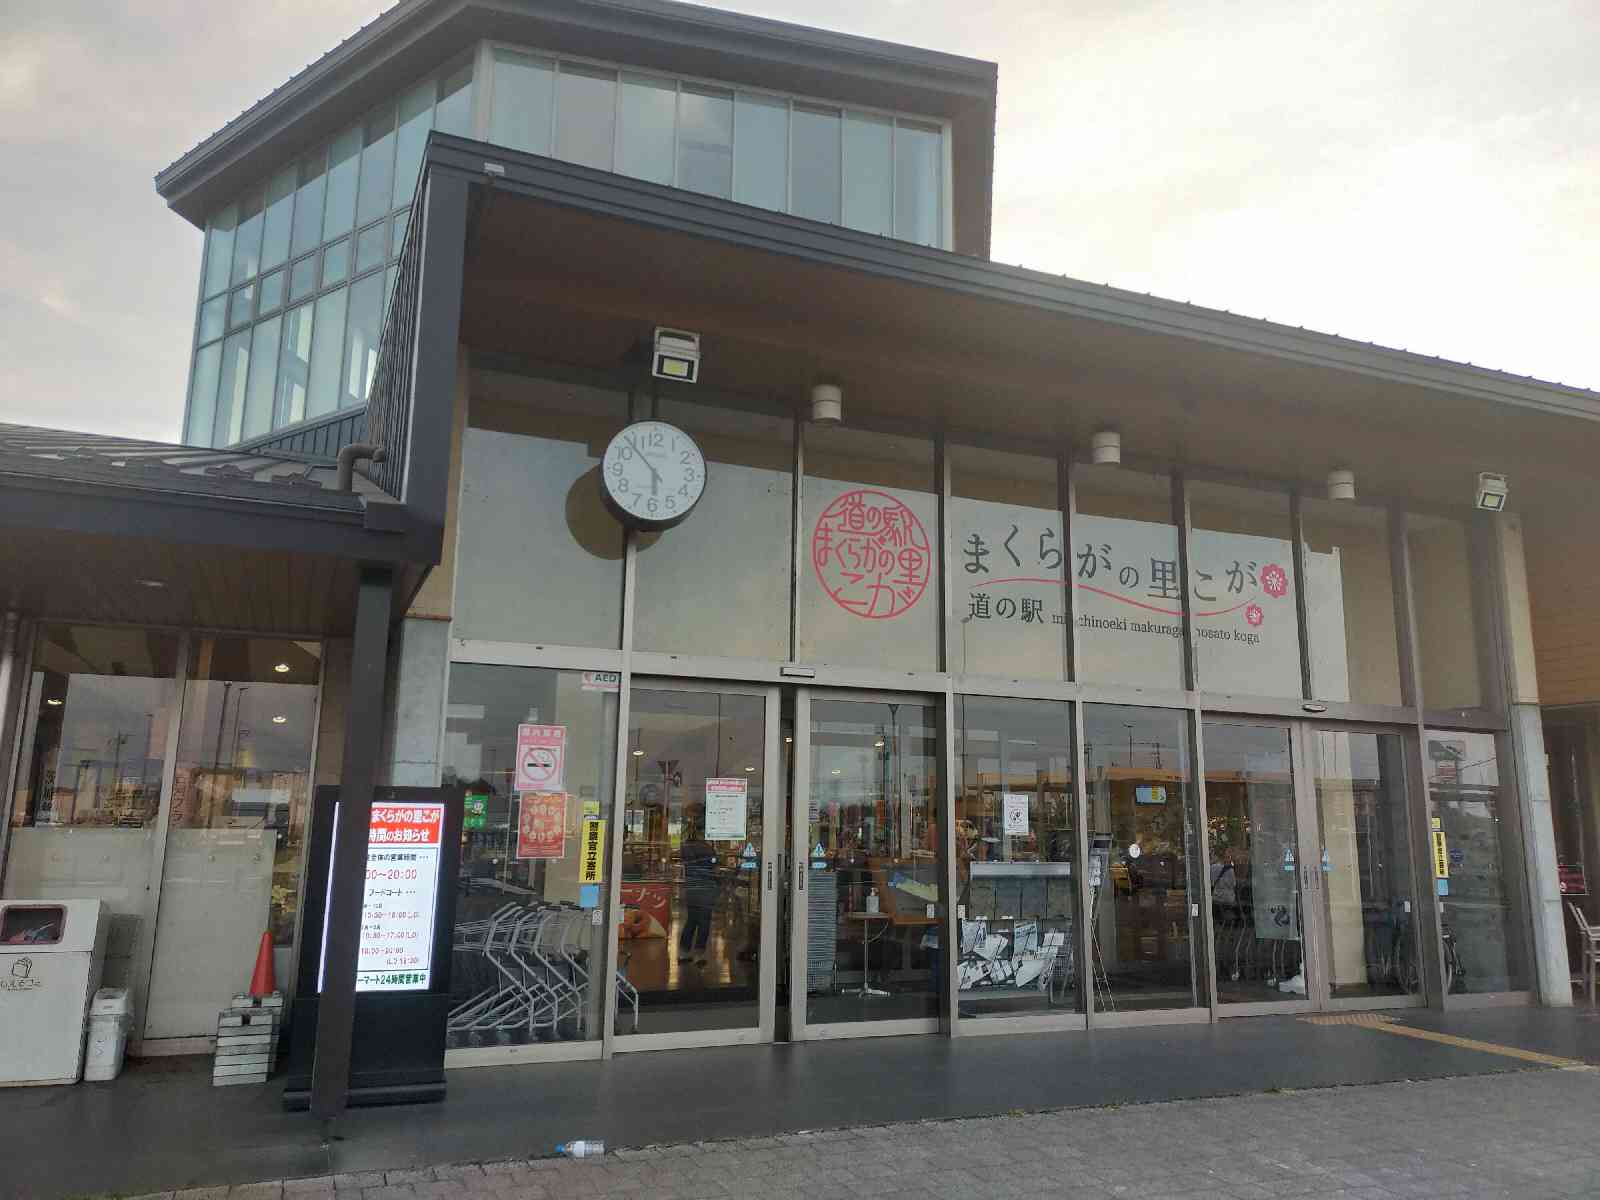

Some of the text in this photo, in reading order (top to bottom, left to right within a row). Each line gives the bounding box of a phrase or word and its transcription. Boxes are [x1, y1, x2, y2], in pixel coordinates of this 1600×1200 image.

[648, 433, 664, 448] 12
[615, 446, 633, 461] 10
[680, 450, 690, 465] 2
[612, 463, 623, 477] 9
[683, 468, 695, 483] 3
[617, 478, 629, 493] 8
[631, 493, 642, 507] 7
[647, 498, 658, 512] 6
[664, 495, 676, 510] 5
[968, 592, 1044, 624] 道の駅
[595, 673, 617, 682] AED
